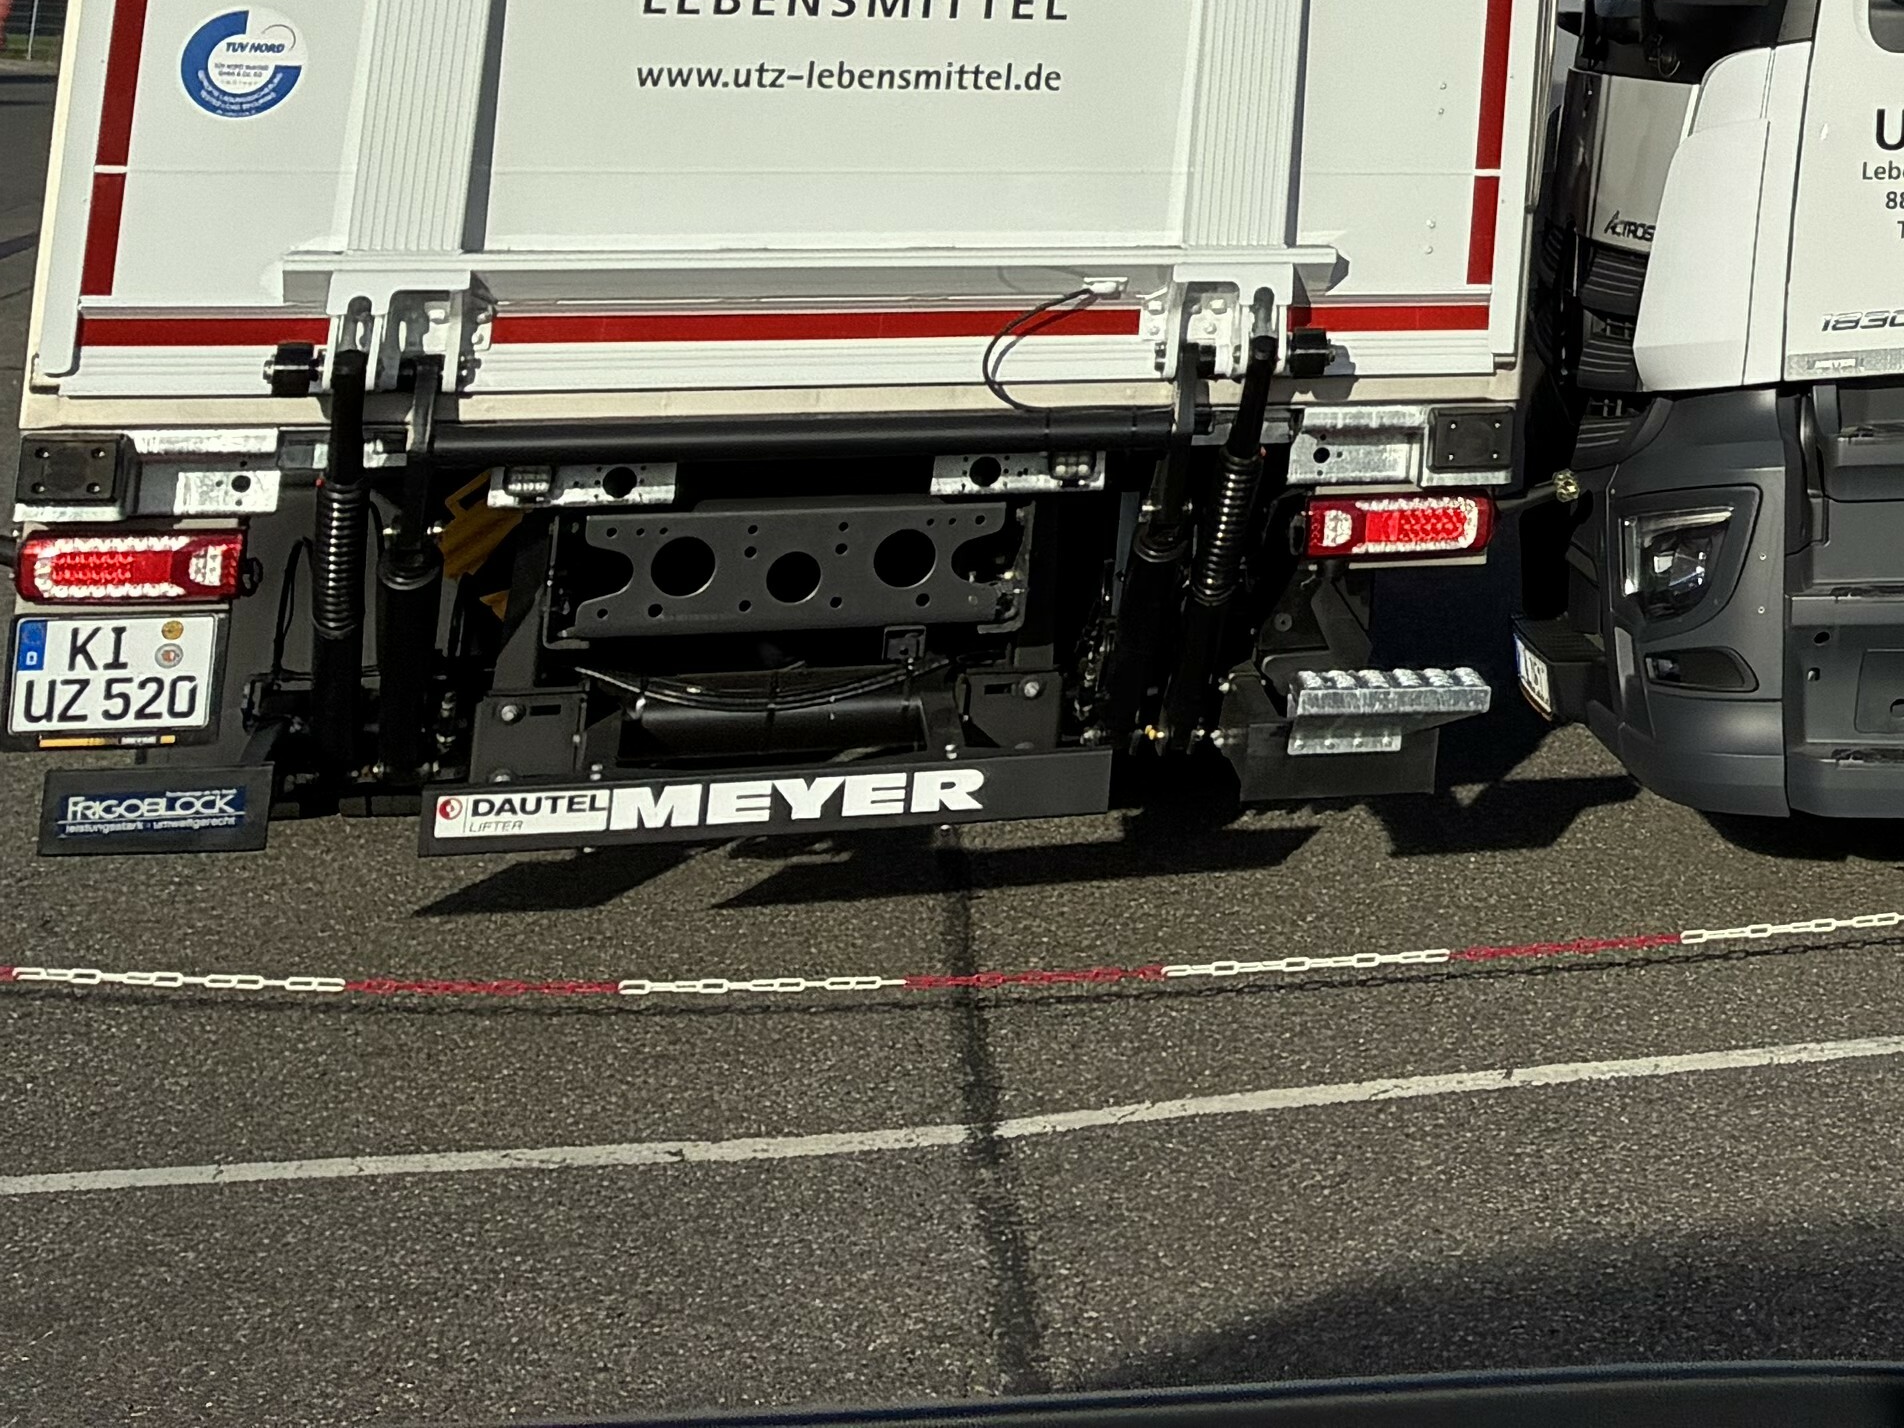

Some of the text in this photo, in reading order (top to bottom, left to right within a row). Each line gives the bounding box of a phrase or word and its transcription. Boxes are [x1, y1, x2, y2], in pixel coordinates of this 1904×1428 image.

[636, 60, 1062, 92] www.utz-lebensmittel.de
[67, 625, 129, 672] KI
[24, 674, 198, 724] UZ 520
[470, 768, 985, 832] DAUTEL MEYER
[469, 819, 523, 833] LIFTER
